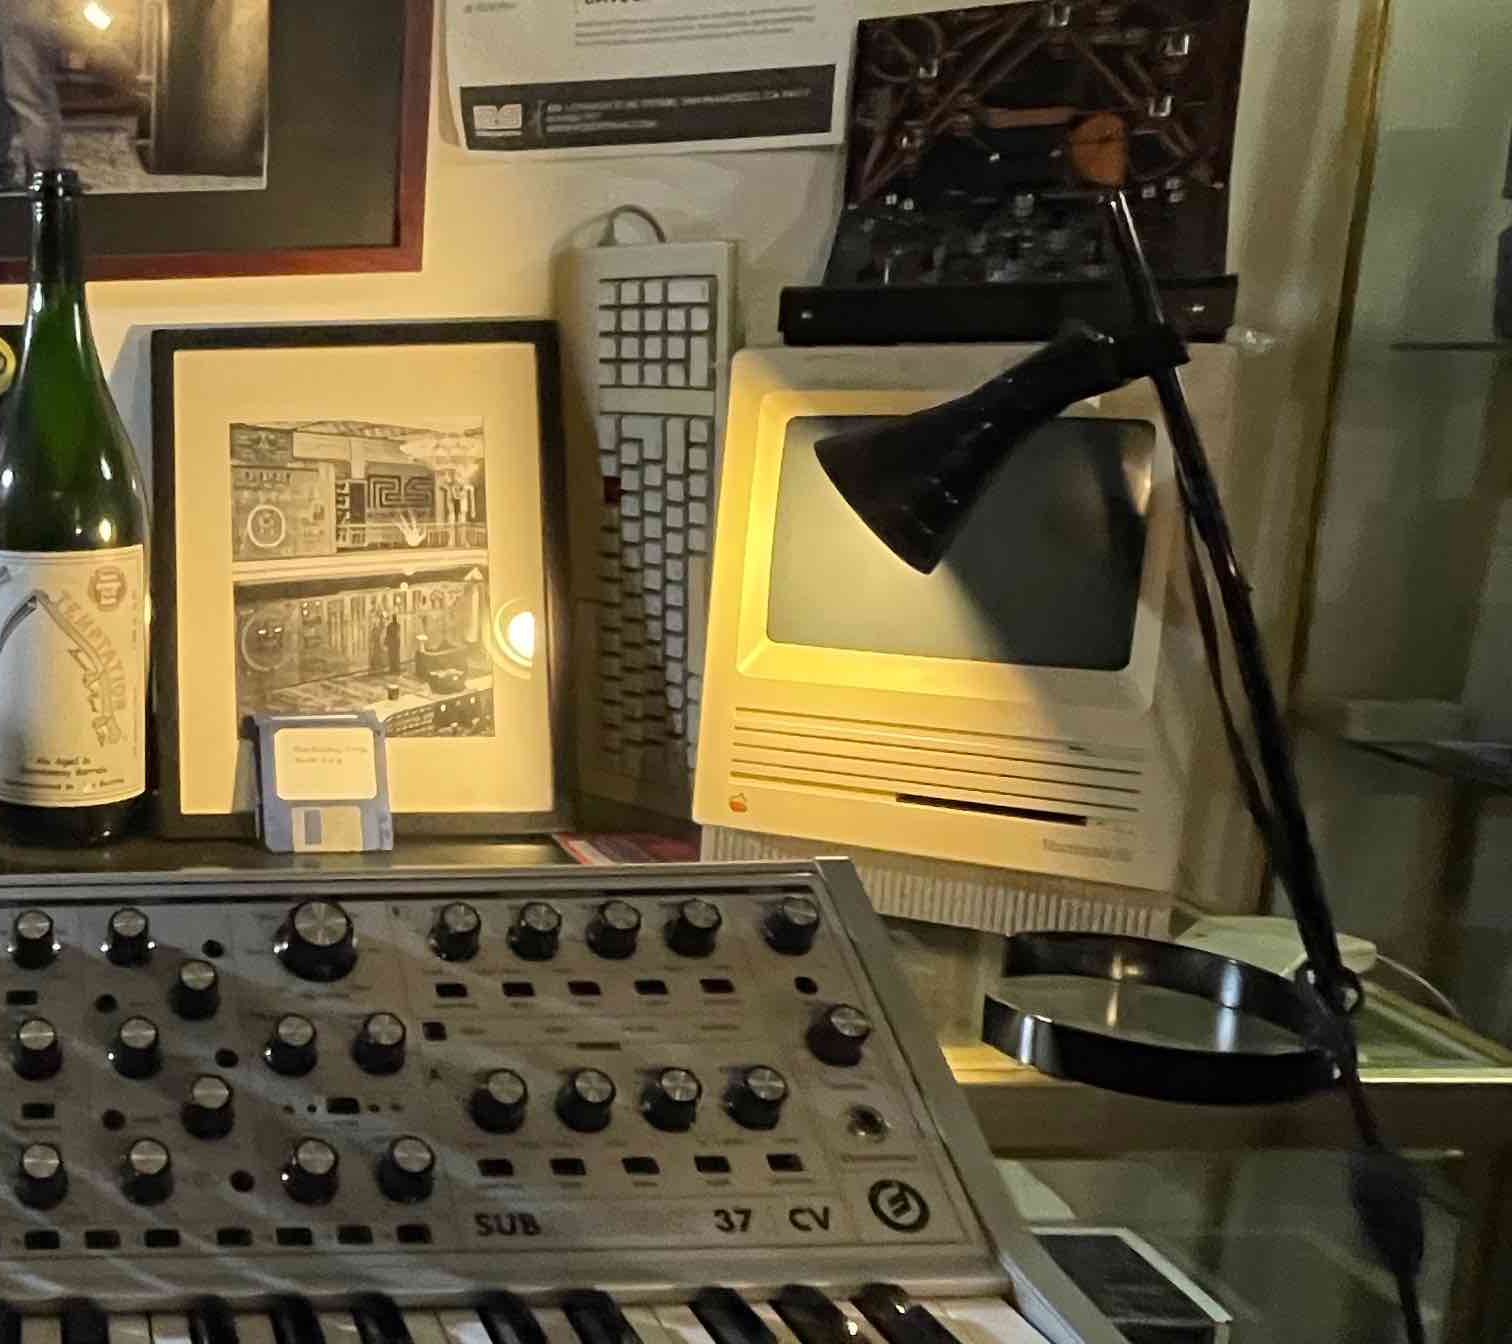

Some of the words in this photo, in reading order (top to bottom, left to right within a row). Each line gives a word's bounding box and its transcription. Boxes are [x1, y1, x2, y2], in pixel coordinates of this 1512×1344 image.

[473, 1212, 542, 1237] SUB
[713, 1208, 753, 1233] 37
[788, 1206, 830, 1232] CV
